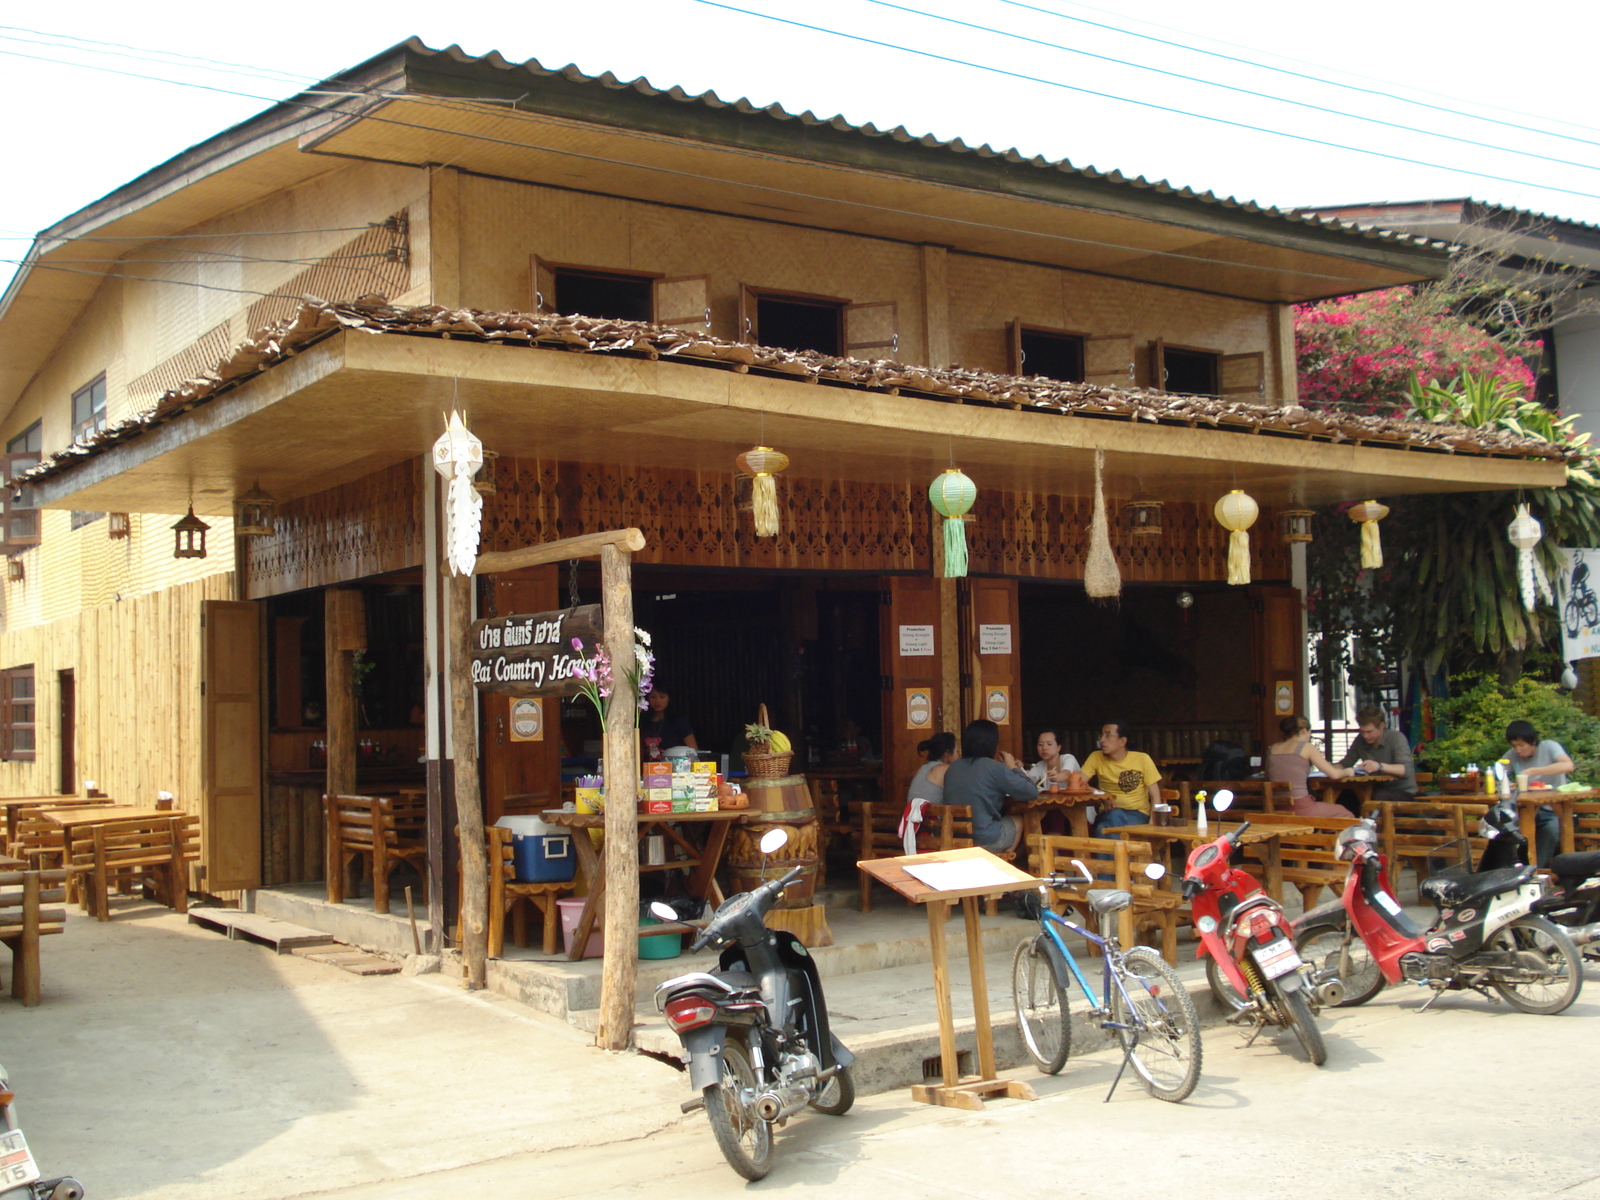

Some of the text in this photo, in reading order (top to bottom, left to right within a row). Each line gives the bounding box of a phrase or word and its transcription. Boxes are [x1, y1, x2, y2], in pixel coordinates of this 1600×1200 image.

[480, 624, 501, 650] ปาย
[471, 659, 493, 683] Pai
[494, 656, 546, 688] Country
